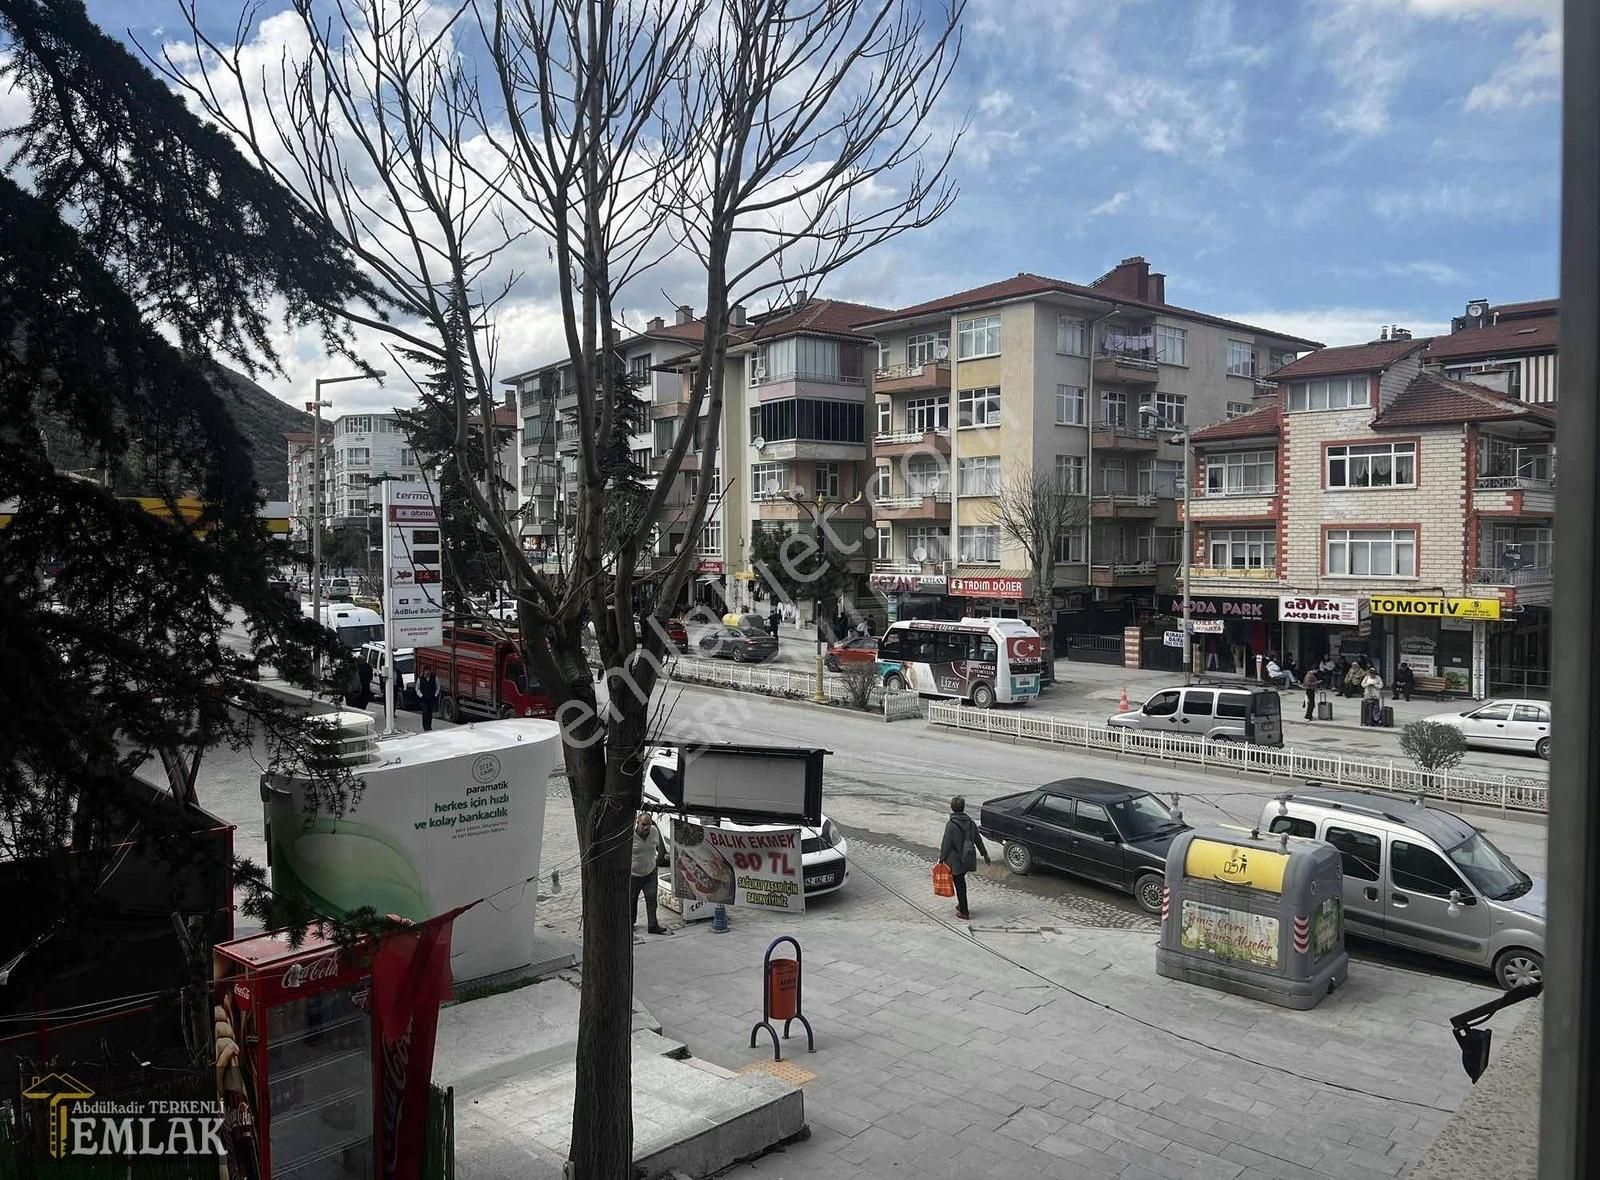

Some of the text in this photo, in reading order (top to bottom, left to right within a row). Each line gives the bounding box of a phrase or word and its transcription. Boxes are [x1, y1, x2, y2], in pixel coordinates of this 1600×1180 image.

[963, 579, 1022, 592] TADIM DÖNER
[1221, 602, 1263, 616] PARK
[1284, 598, 1340, 611] GÜVEN
[1371, 599, 1460, 615] TOMOTİV
[466, 781, 509, 796] paramatik
[434, 793, 509, 813] herkes için hızlı
[414, 821, 427, 830] ve
[429, 816, 457, 828] kolay
[459, 807, 508, 823] bankacılık
[710, 831, 796, 849] BALIK EKMEK
[732, 852, 796, 877] 80 TL
